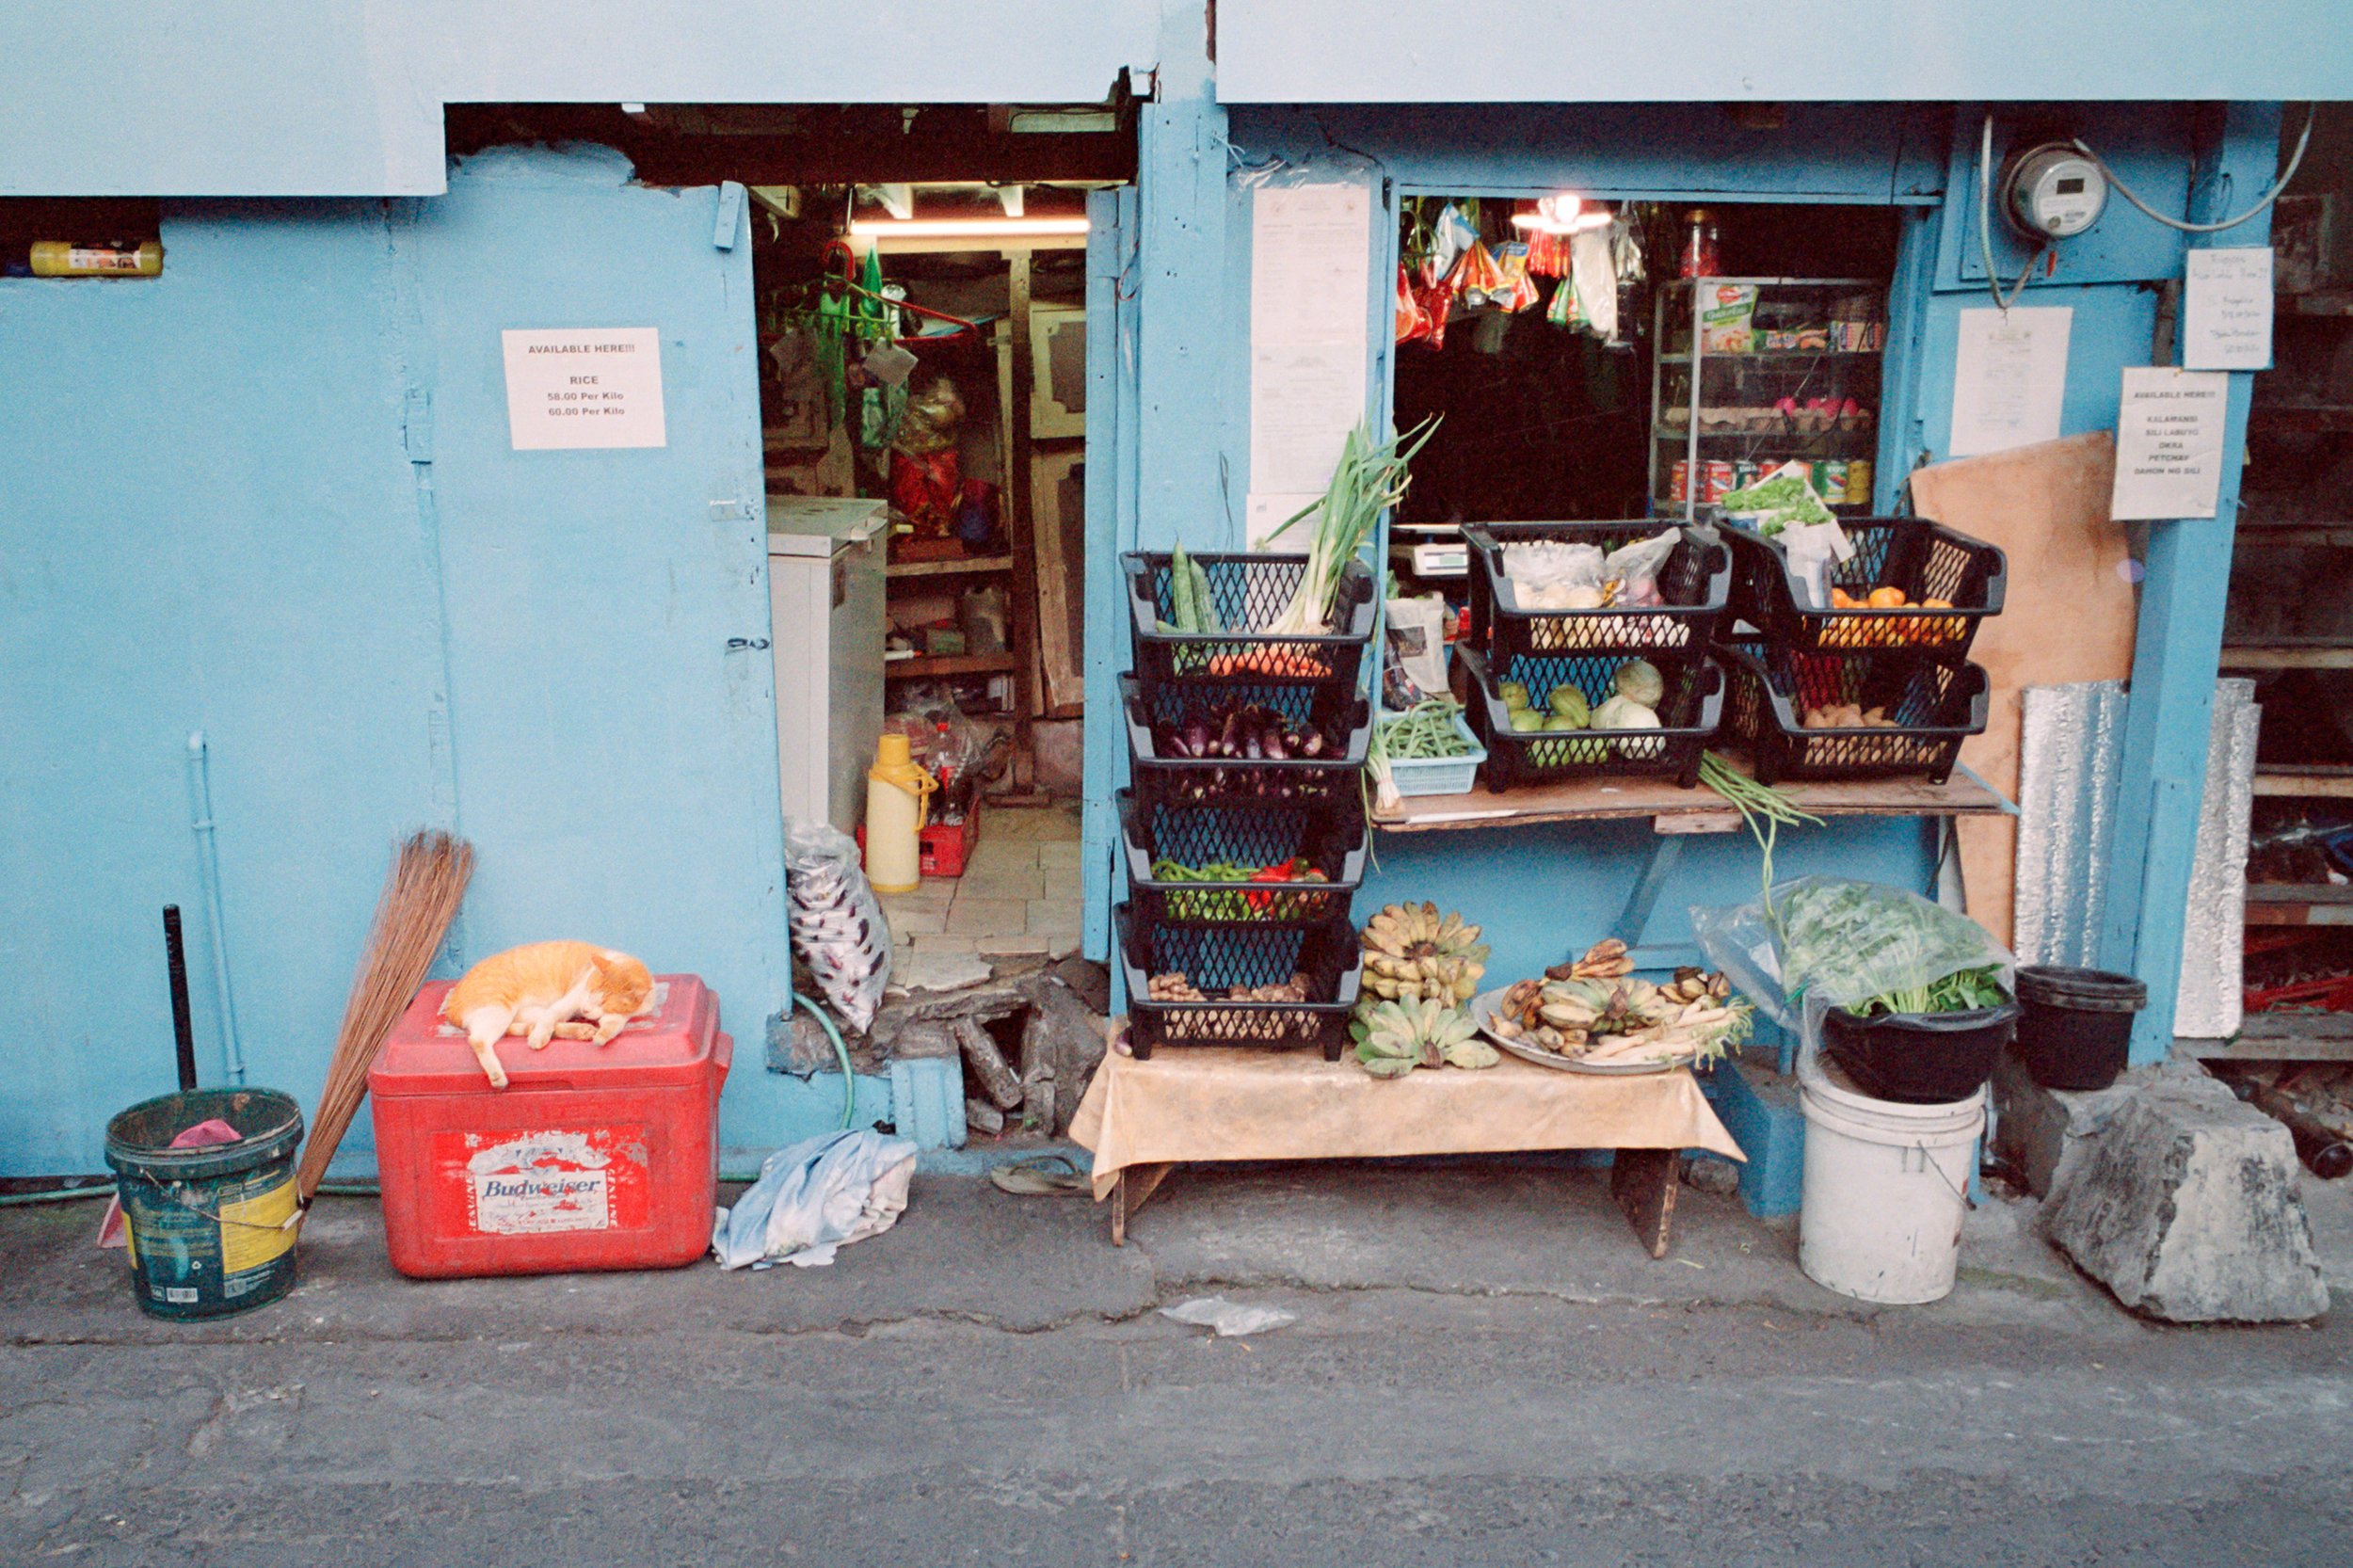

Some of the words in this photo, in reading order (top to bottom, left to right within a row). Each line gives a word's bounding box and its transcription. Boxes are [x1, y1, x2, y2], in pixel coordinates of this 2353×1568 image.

[528, 344, 591, 354] AVAILABLE
[594, 344, 635, 353] HERE!!!
[569, 376, 599, 385] RICE
[547, 392, 577, 401] 58.00
[580, 392, 599, 401] Per
[601, 392, 624, 400] Kilo
[2134, 391, 2181, 399] AVAILABLE
[548, 408, 579, 416] 60.00
[582, 407, 600, 416] Per
[603, 407, 625, 415] Kilo
[2158, 441, 2184, 450] OKRA
[483, 1177, 600, 1198] Budweiser
